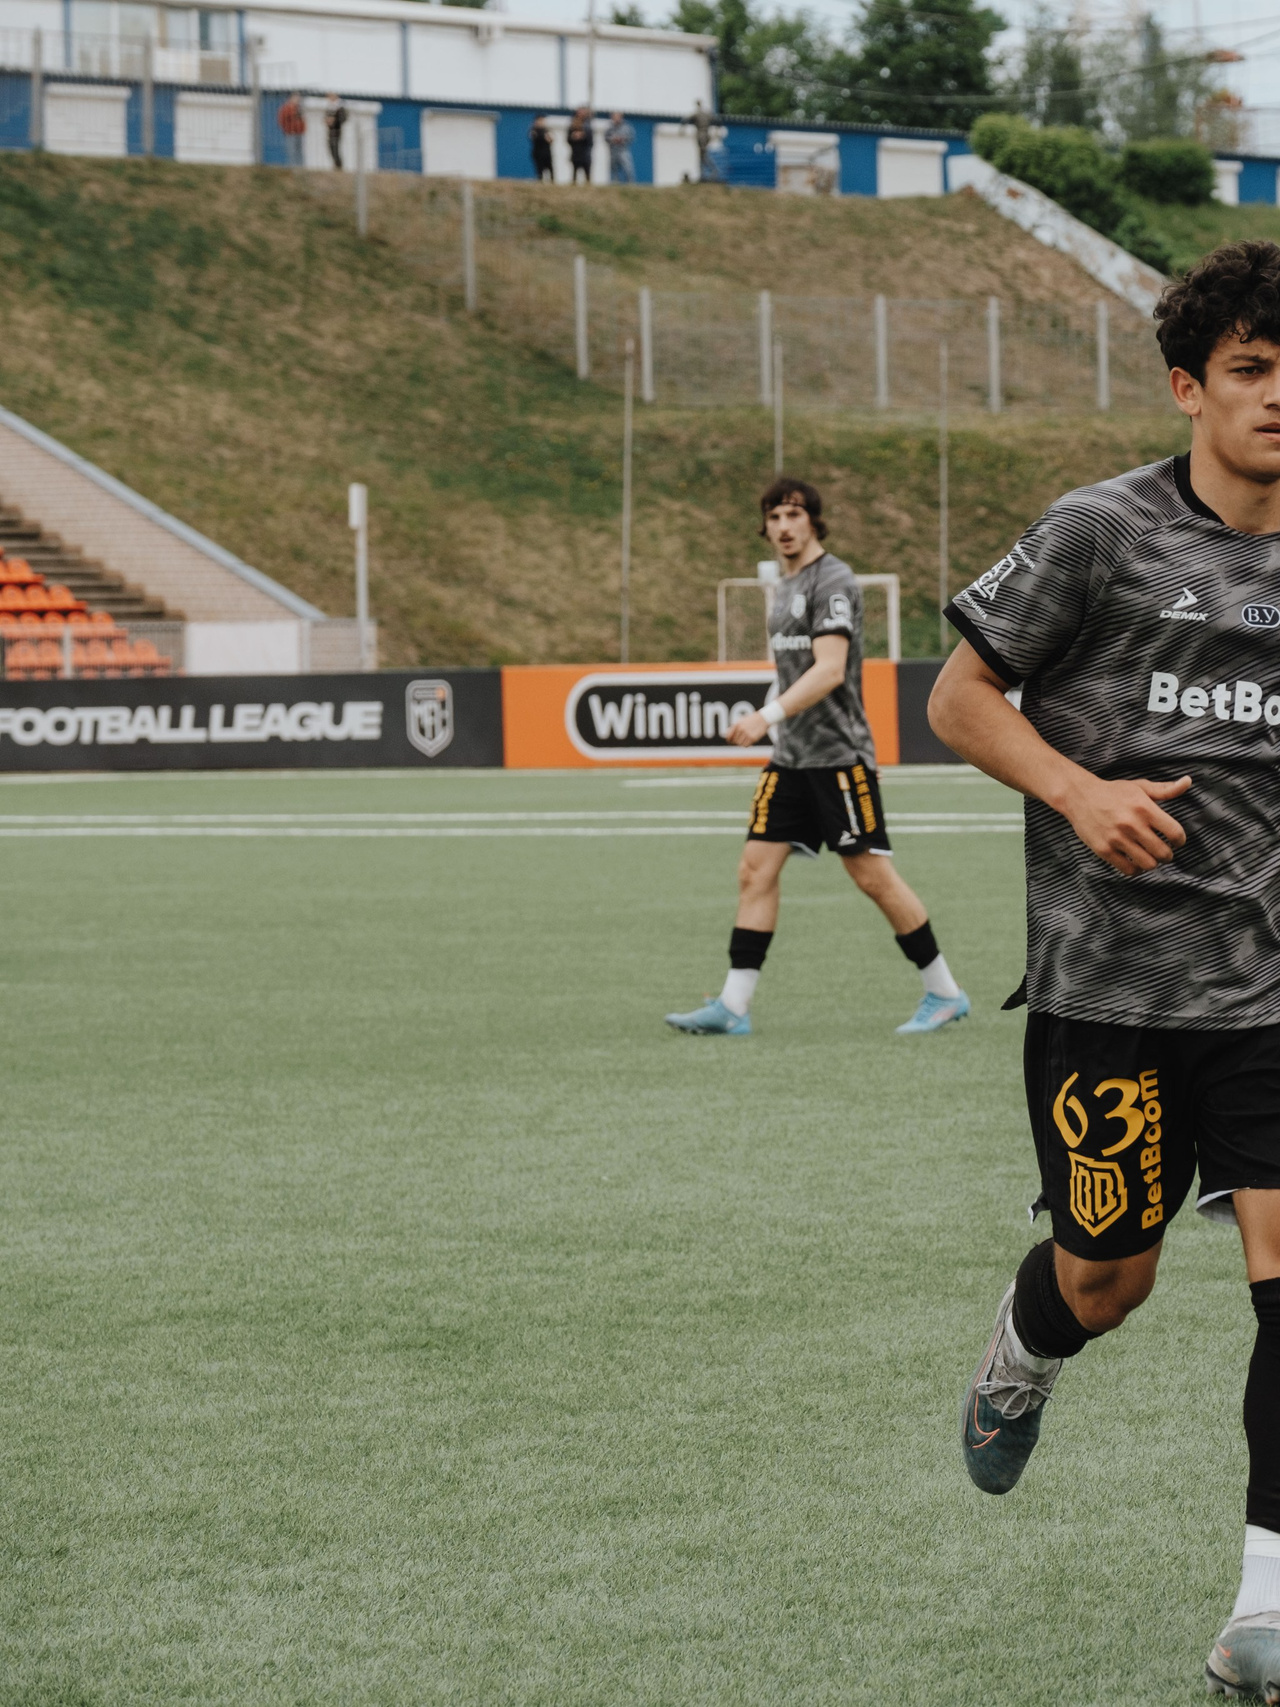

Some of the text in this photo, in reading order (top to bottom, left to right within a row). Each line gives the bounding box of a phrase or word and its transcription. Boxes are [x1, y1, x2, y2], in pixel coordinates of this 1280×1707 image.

[1159, 609, 1209, 622] DEMIX
[209, 700, 384, 743] LEAGUE
[1053, 1071, 1146, 1157] 63
[1139, 1068, 1164, 1230] BetBoom
